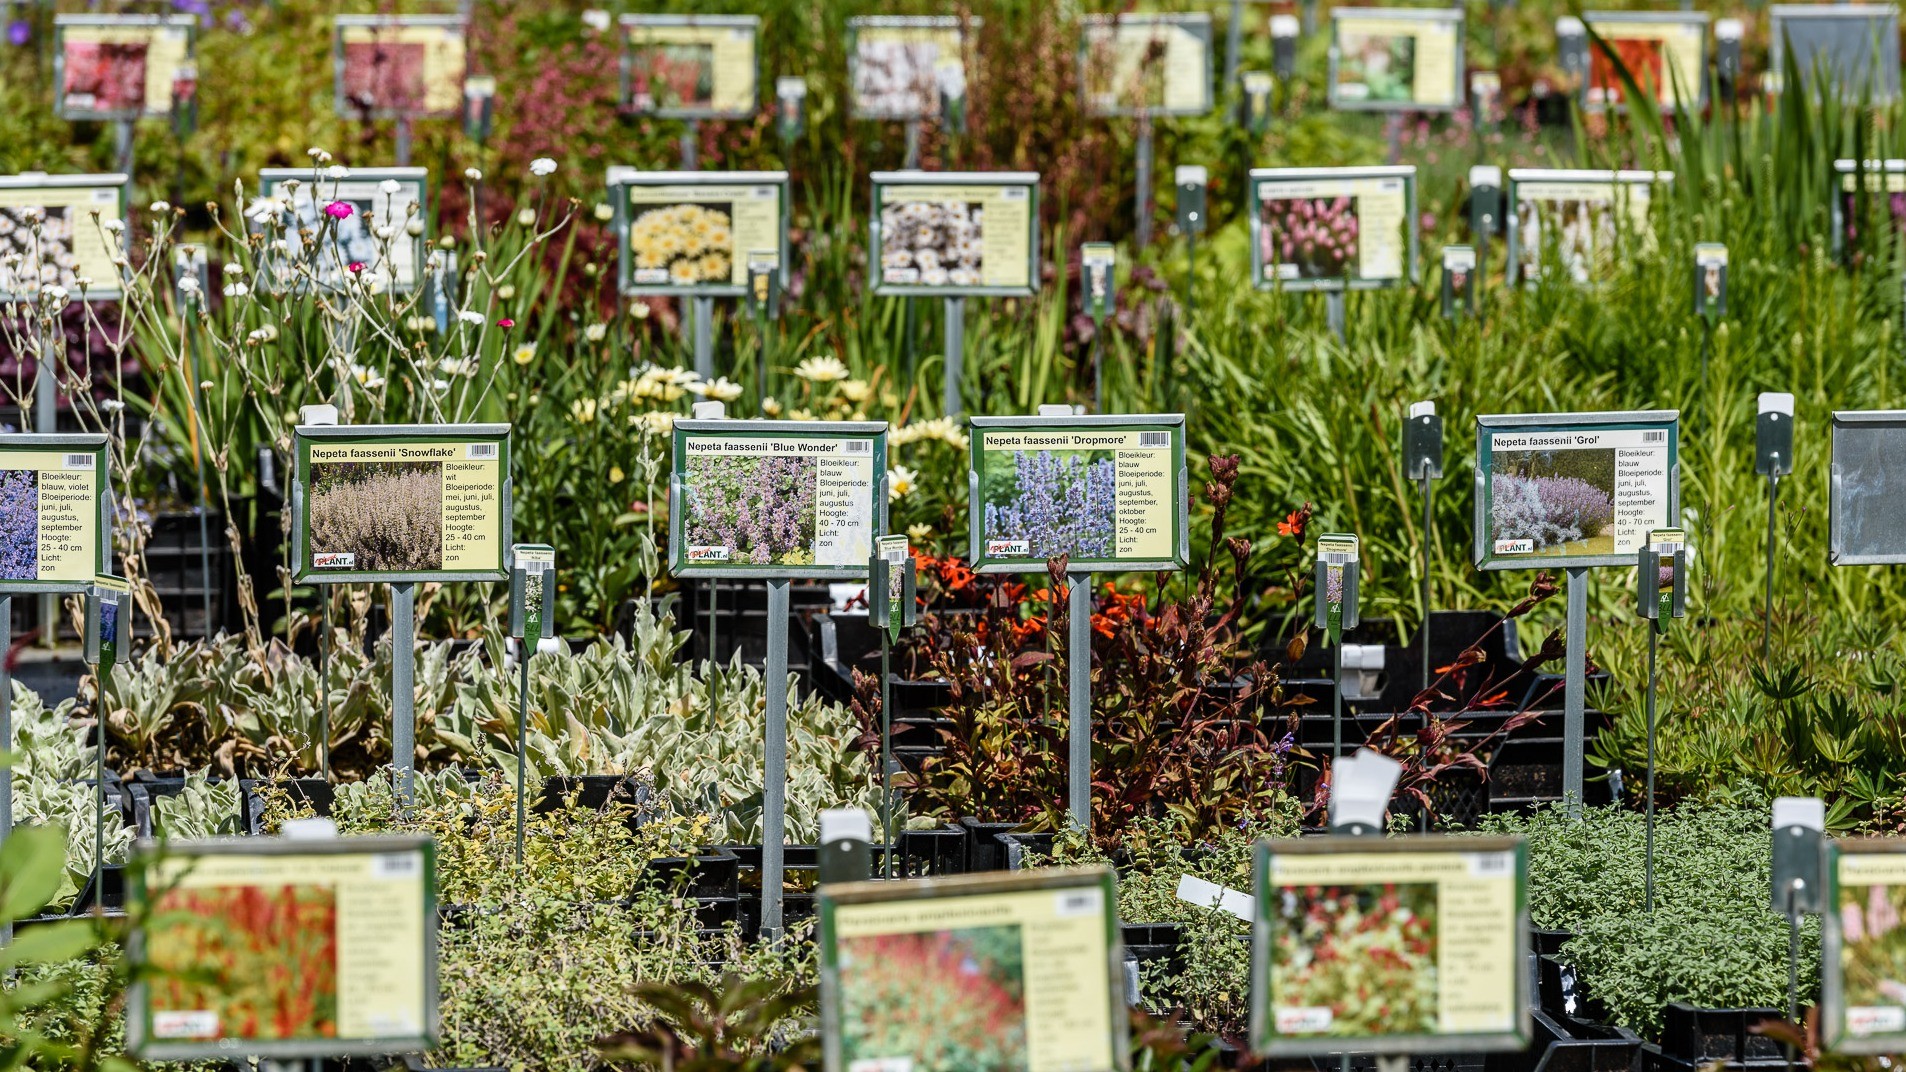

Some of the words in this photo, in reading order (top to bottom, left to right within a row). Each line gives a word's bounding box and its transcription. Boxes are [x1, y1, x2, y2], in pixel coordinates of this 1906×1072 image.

[986, 436, 1021, 447] Nepeta
[1023, 436, 1069, 445] faassenii
[1071, 435, 1127, 446] 'Dropmore'
[1494, 438, 1527, 448] Nepeta
[1529, 436, 1572, 445] faassenii
[1574, 435, 1600, 444] 'Grol'
[688, 442, 722, 453] Nepeta
[724, 442, 768, 451] faassenii
[770, 443, 795, 451] 'Blue
[797, 443, 838, 452] Wonder'
[312, 449, 347, 460] Nepeta
[350, 449, 396, 458] faassenii
[398, 448, 456, 458] 'Snowflake'
[820, 459, 860, 467] Bloeikleur:
[820, 469, 842, 477] blauw
[1118, 471, 1165, 479] Bloeiperiode:
[68, 483, 89, 491] violet
[445, 483, 495, 492] Bloeiperiode:
[820, 479, 869, 488] Bloeiperiode:
[1118, 480, 1134, 488] juni,
[1135, 480, 1148, 488] juli,
[819, 489, 835, 498] juni,
[837, 489, 850, 498] juli,
[1118, 489, 1153, 497] augustus,
[445, 494, 462, 502] mei,
[463, 494, 480, 502] juni,
[481, 494, 495, 502] juli,
[819, 499, 854, 508] augustus
[1119, 499, 1158, 507] september,
[1618, 499, 1655, 507] september
[445, 504, 482, 512] augustus,
[445, 514, 486, 522] september
[819, 510, 849, 518] Hoogte:
[819, 519, 829, 527] 40
[836, 519, 846, 527] 70
[1119, 518, 1147, 526] Hoogte:
[1617, 518, 1626, 526] 40
[1633, 518, 1643, 526] 70
[41, 524, 83, 533] september
[445, 524, 475, 532] Hoogte:
[41, 544, 52, 552] 25
[58, 544, 69, 552] 40
[41, 564, 55, 572] zon
